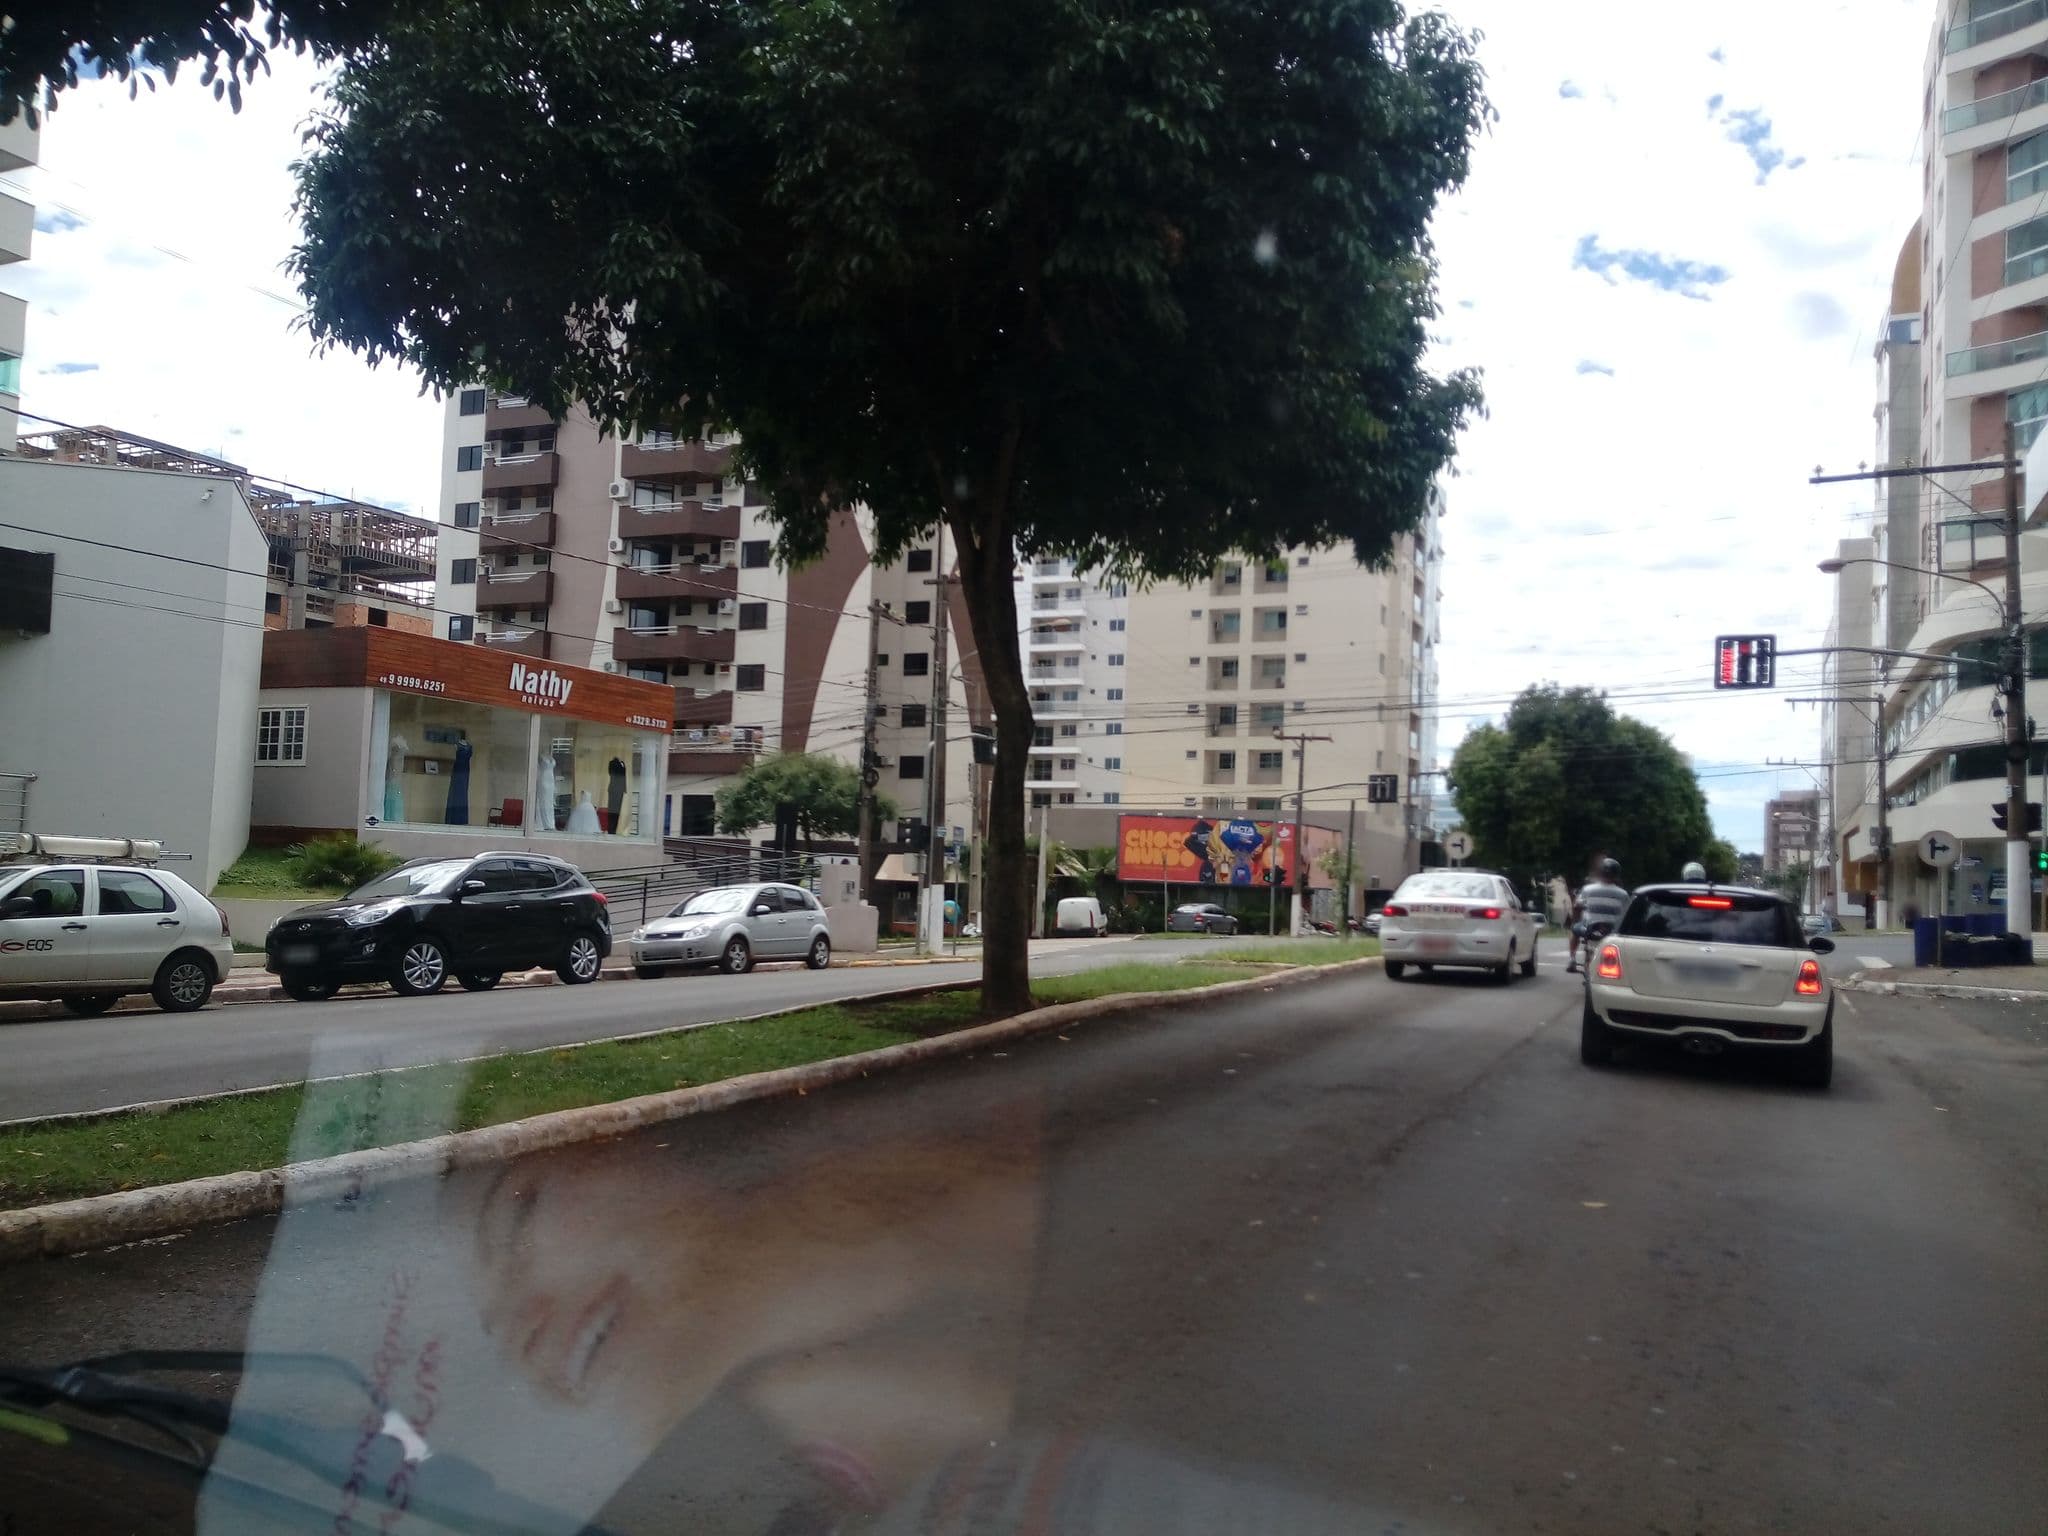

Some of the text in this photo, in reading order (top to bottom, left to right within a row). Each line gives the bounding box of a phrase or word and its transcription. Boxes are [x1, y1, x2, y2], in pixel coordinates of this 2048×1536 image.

[396, 675, 445, 692] 9999.6251
[509, 662, 573, 705] Nathy
[521, 695, 555, 707] noivas
[1124, 847, 1196, 868] MUNDO
[26, 939, 54, 952] EQS
